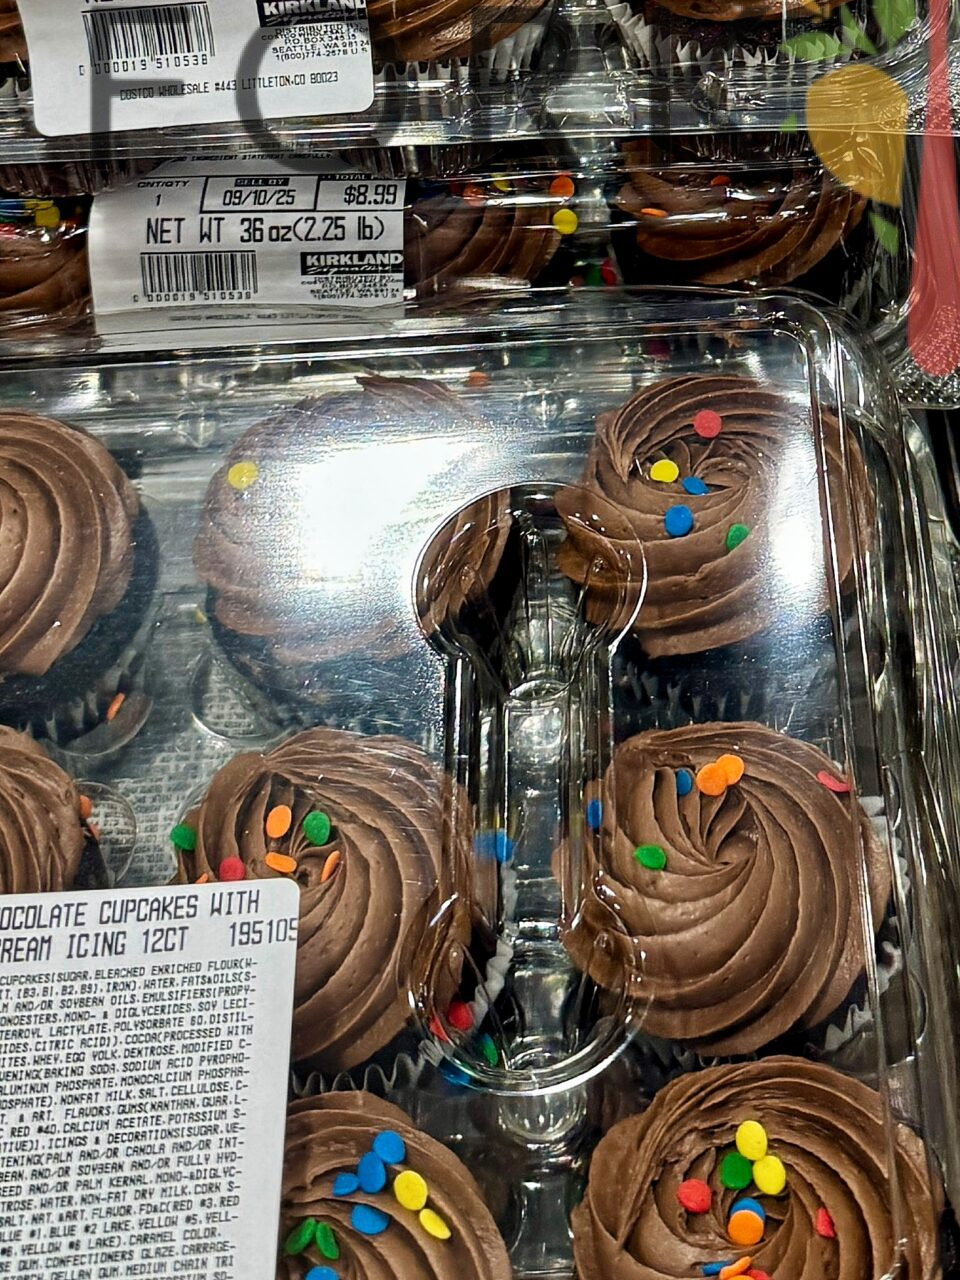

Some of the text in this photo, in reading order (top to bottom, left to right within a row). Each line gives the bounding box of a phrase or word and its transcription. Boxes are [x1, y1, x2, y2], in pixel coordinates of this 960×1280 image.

[155, 184, 398, 206] 1 09/10/25 $8.99
[147, 218, 185, 244] NET
[200, 217, 225, 243] WT
[358, 216, 385, 241] lb)
[306, 253, 404, 266] KIRKLAND
[99, 893, 197, 924] CUPCAKES
[210, 889, 260, 916] WITH
[0, 935, 52, 963] REAM
[67, 930, 126, 958] ICING
[141, 926, 189, 953] 12CT
[227, 1024, 253, 1037] WITH
